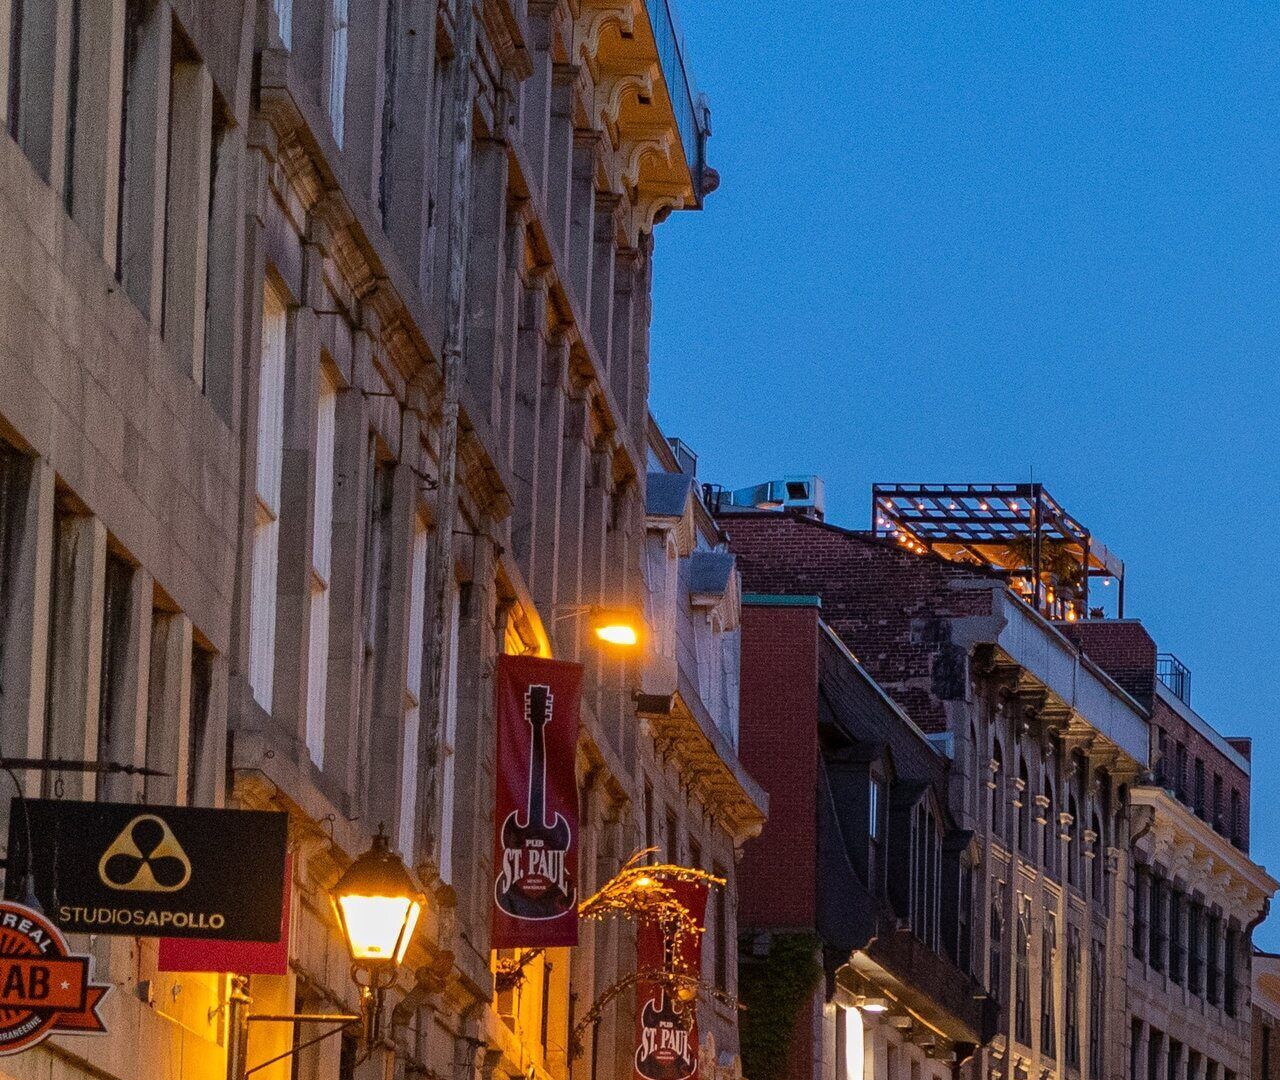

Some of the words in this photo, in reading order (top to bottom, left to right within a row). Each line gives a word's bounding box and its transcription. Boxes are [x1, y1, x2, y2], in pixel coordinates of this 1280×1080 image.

[525, 839, 545, 848] PUB
[527, 849, 568, 897] PAUL
[0, 912, 53, 954] REAL
[660, 1029, 690, 1066] PAUL
